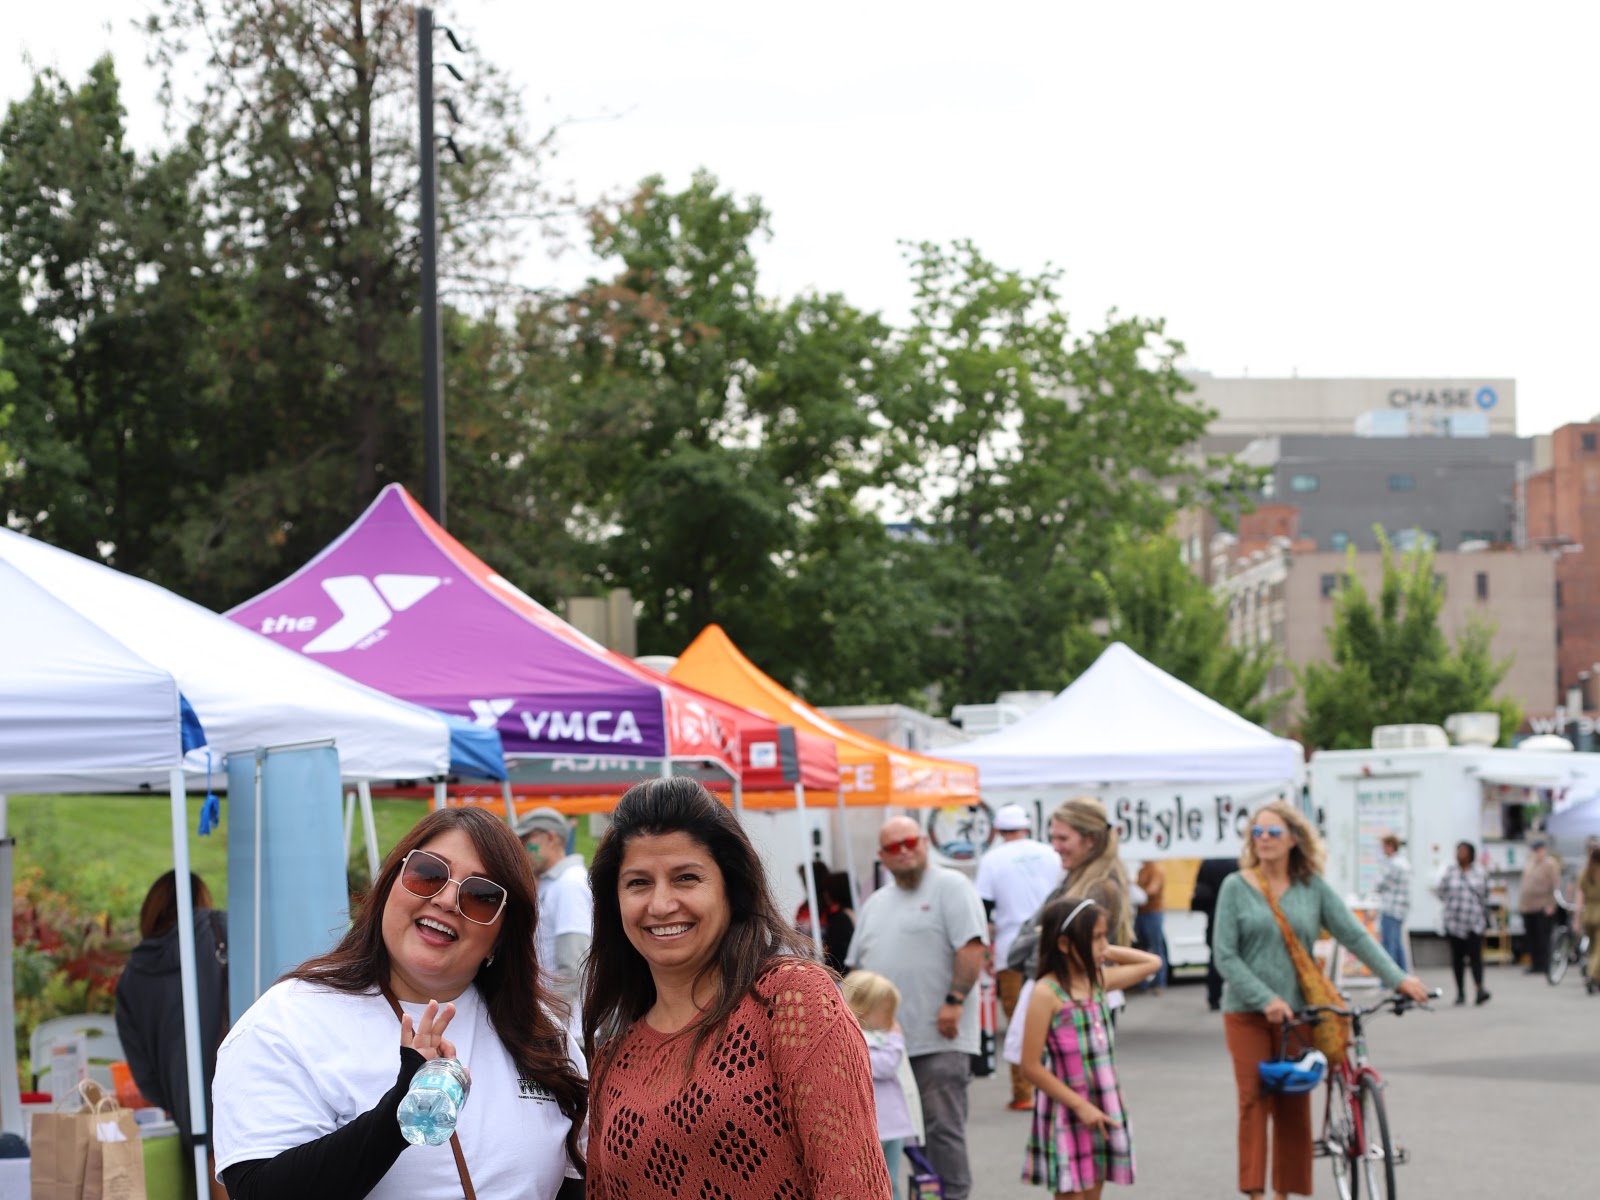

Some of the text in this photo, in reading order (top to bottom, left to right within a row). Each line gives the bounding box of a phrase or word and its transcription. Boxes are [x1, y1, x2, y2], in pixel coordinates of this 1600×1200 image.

[1388, 387, 1471, 409] CHASE
[261, 615, 318, 635] the
[519, 710, 644, 744] YMCA
[1115, 795, 1203, 850] Style
